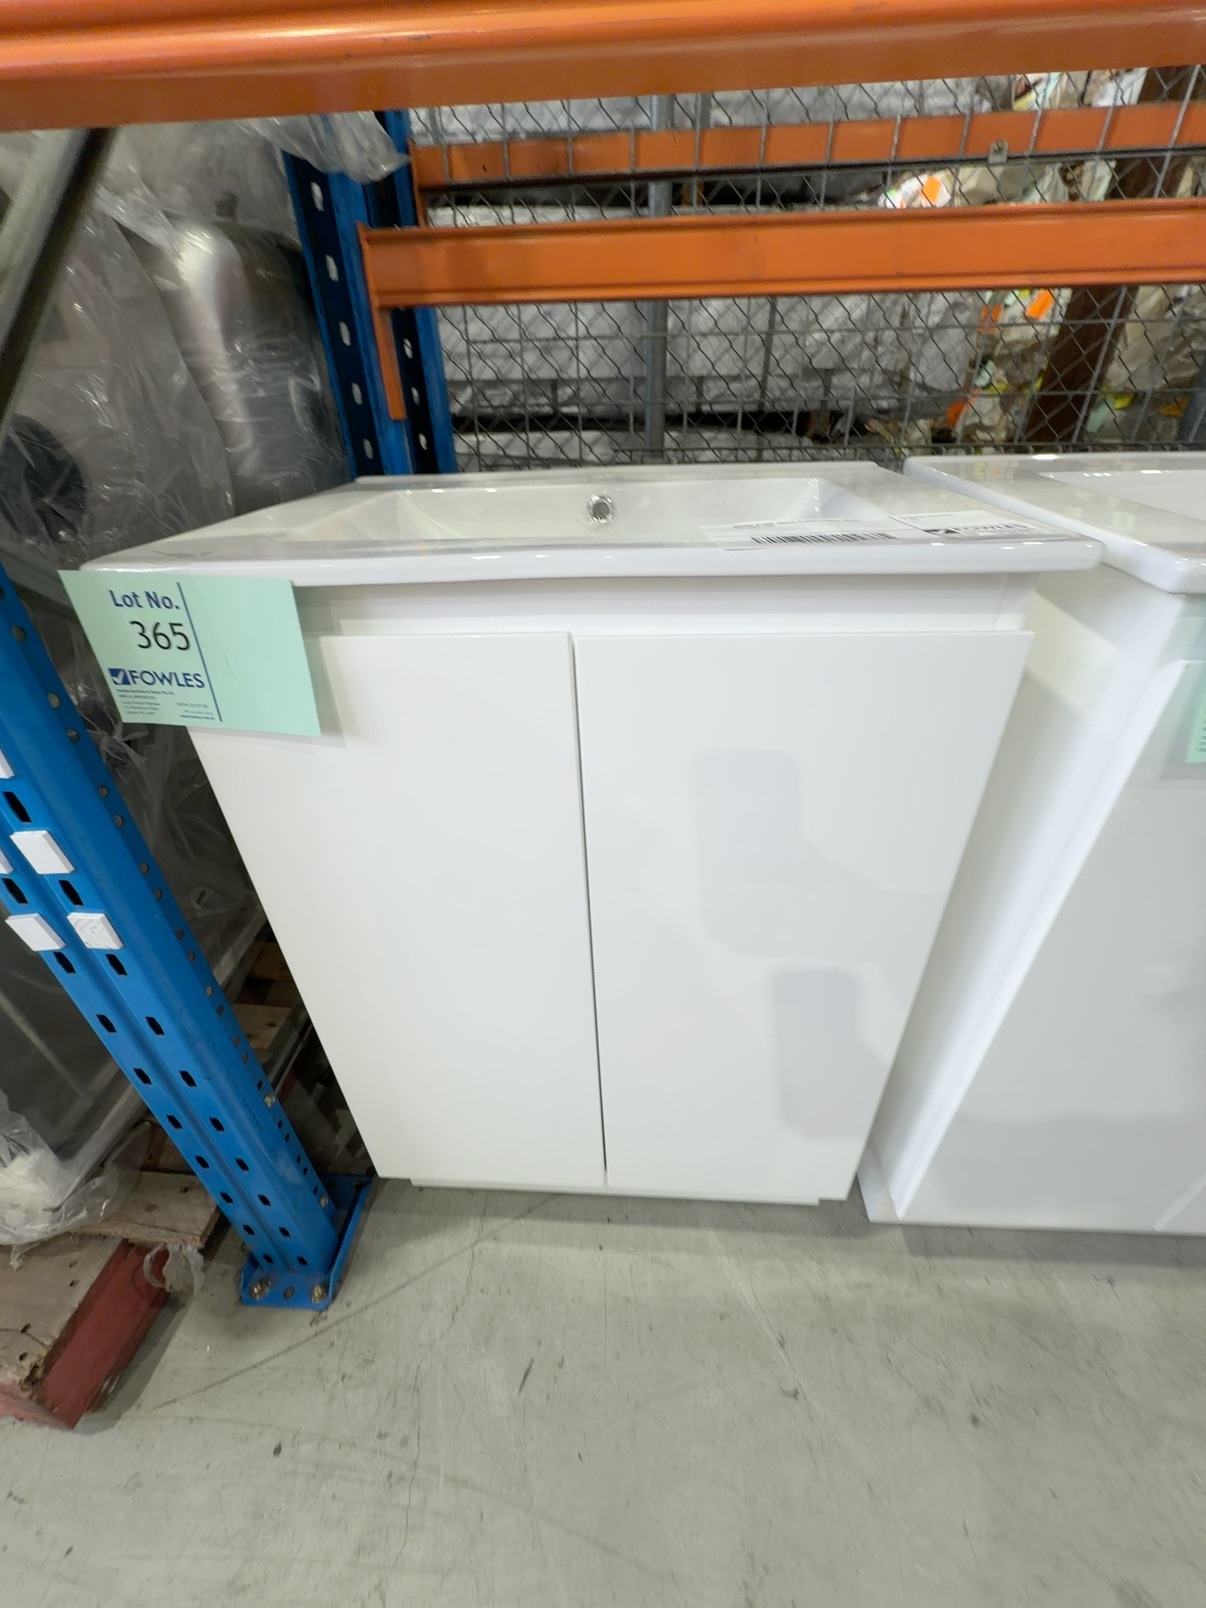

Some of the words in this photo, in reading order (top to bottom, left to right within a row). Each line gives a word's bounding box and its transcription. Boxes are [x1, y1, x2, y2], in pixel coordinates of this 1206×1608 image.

[109, 590, 143, 608] Lot
[145, 591, 180, 609] No.
[130, 620, 190, 650] 365
[129, 670, 205, 688] FOWLES
